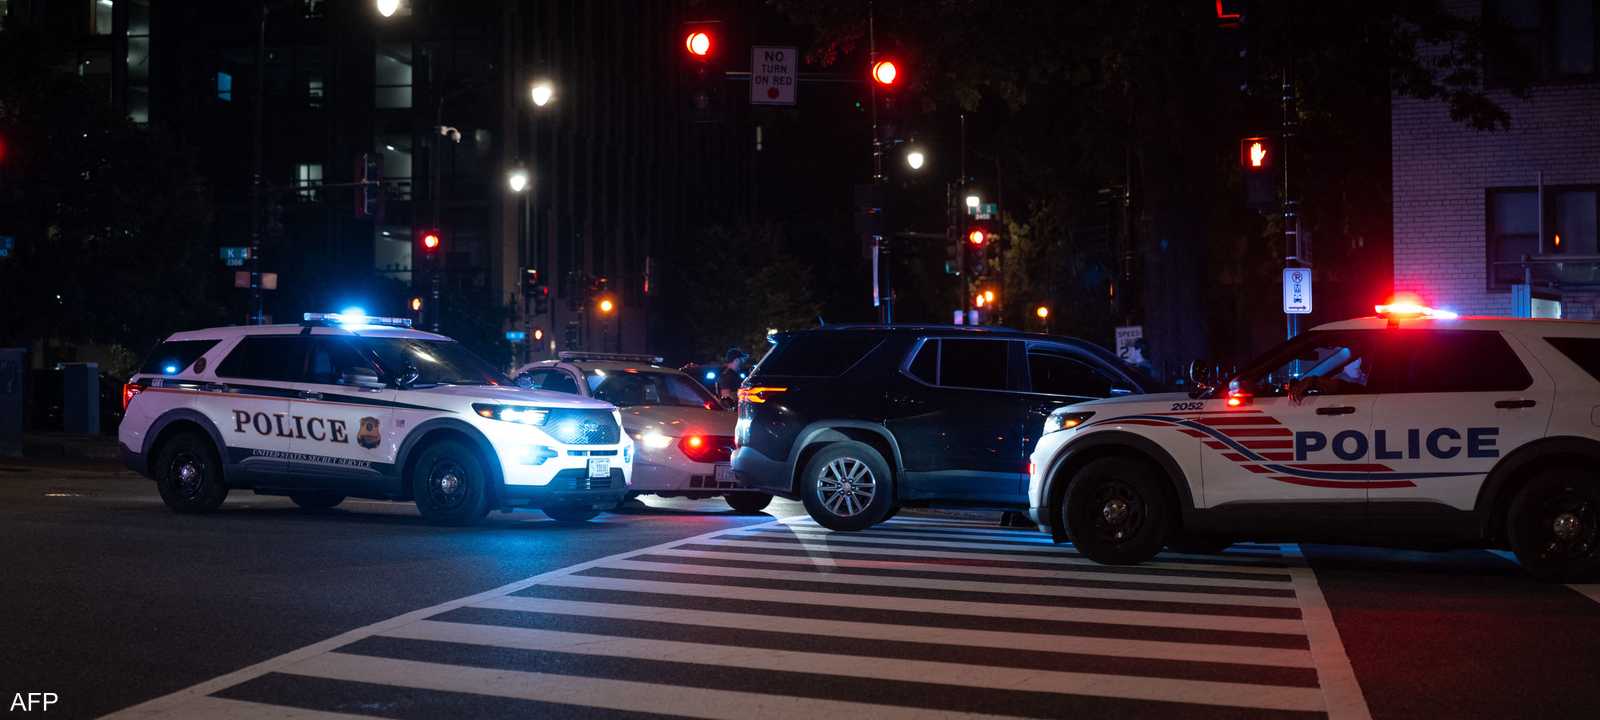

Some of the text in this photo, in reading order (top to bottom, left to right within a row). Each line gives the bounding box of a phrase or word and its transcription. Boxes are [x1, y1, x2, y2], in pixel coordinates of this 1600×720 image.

[764, 51, 784, 62] NO
[761, 64, 788, 73] TURN
[755, 75, 792, 86] ON RED
[1170, 401, 1204, 411] 2052
[231, 409, 349, 444] POLICE
[1295, 427, 1500, 461] POLICE
[252, 448, 280, 457] UNITED
[280, 451, 307, 460] STATES
[308, 454, 336, 463] SECRET
